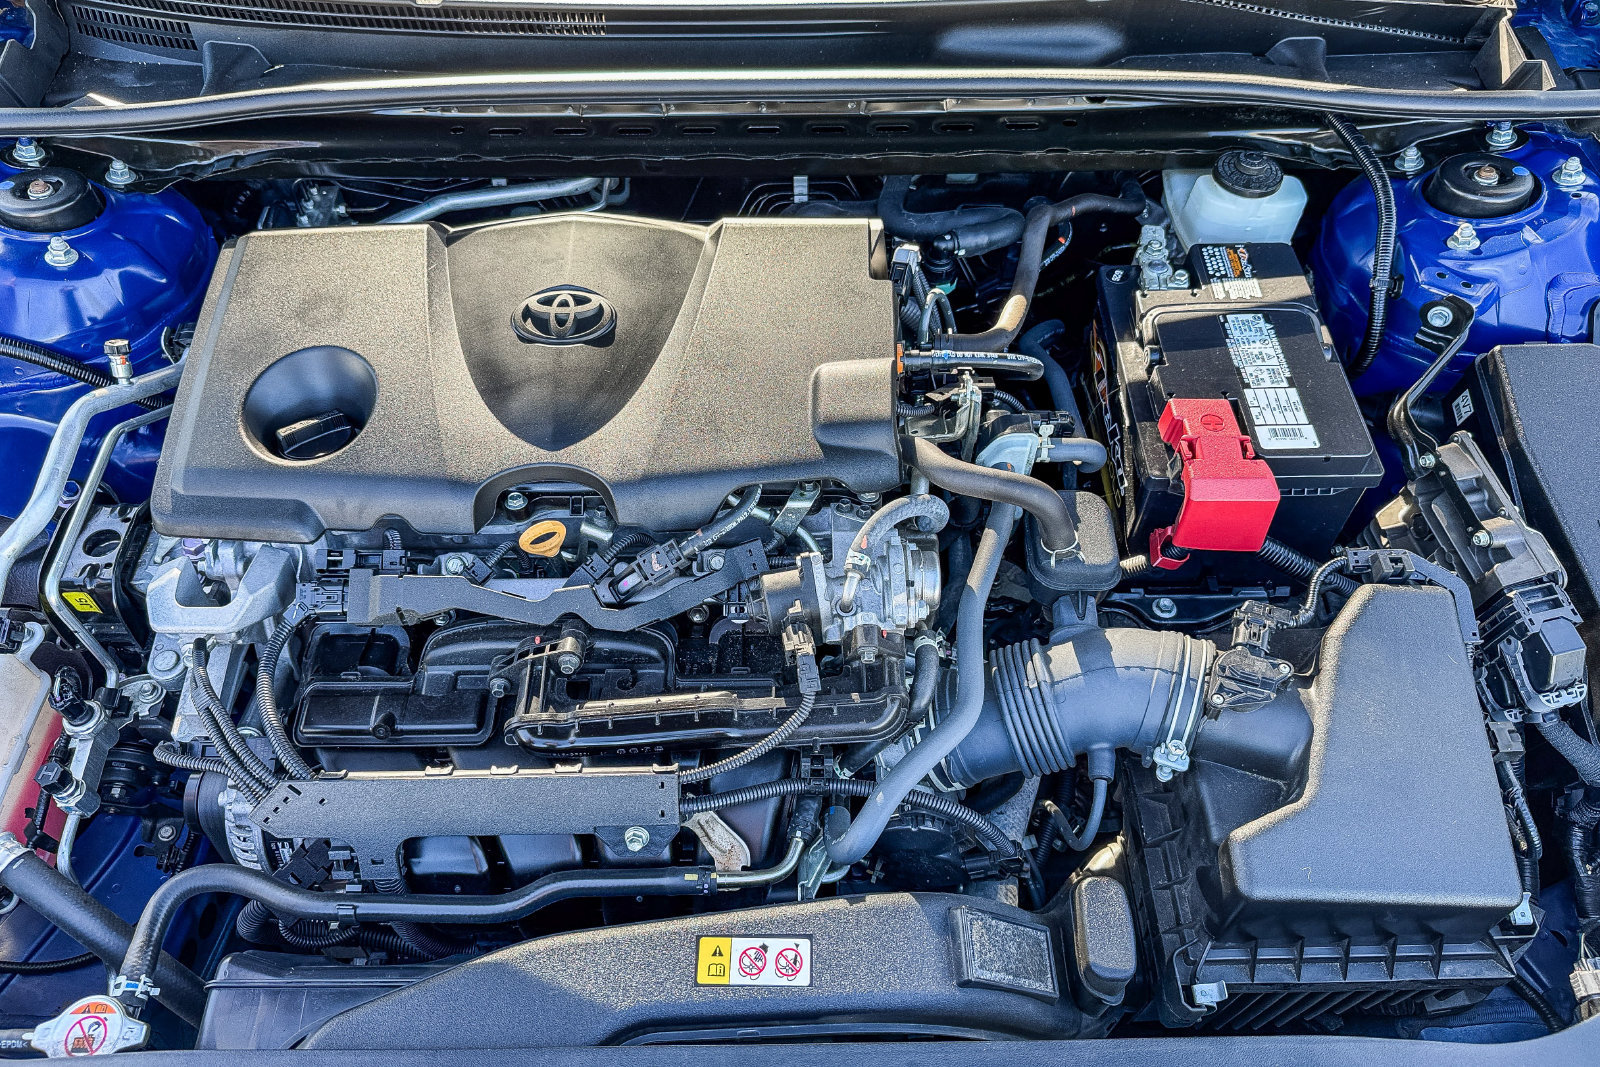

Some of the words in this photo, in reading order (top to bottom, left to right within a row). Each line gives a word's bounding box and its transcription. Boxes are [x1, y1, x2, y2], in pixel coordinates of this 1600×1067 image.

[1267, 329, 1283, 355] DANGER
[1276, 353, 1292, 378] POISON
[1461, 394, 1472, 415] 4V7
[37, 765, 58, 781] H
